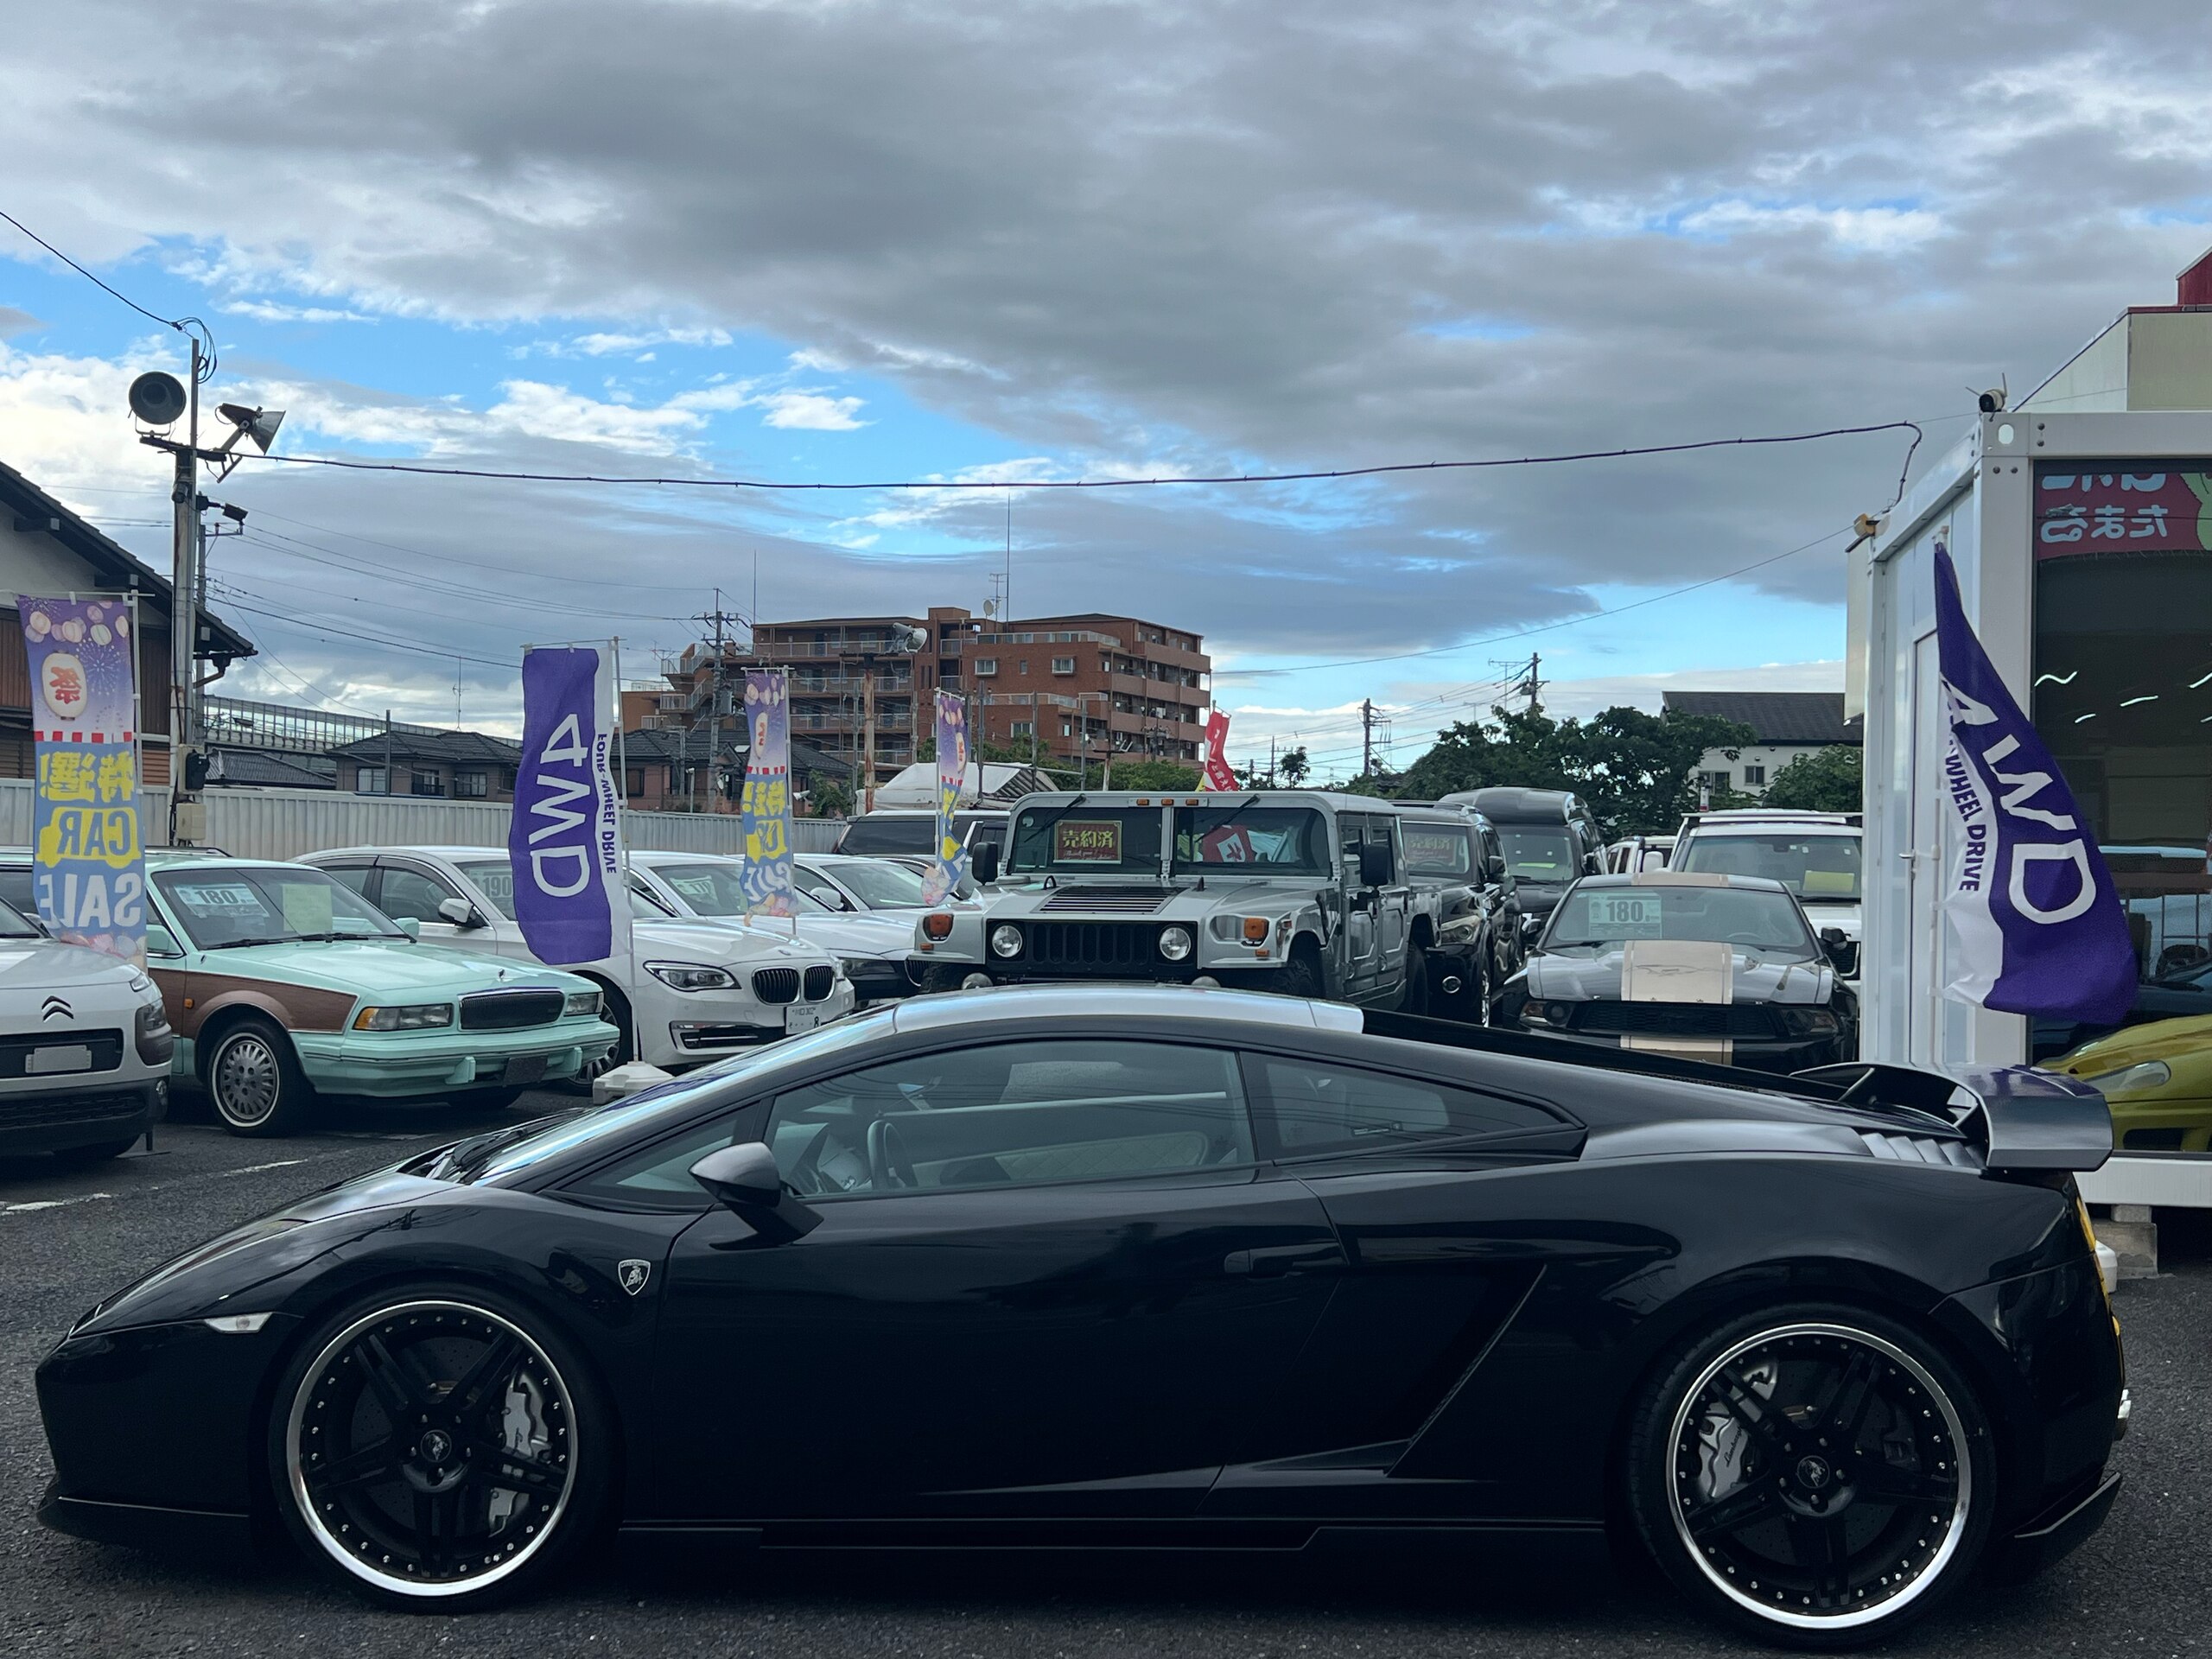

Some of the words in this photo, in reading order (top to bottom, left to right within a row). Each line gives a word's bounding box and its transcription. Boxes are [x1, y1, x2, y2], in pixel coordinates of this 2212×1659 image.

[1062, 830, 1114, 849] 売約済
[1958, 824, 1986, 892] DRIVE
